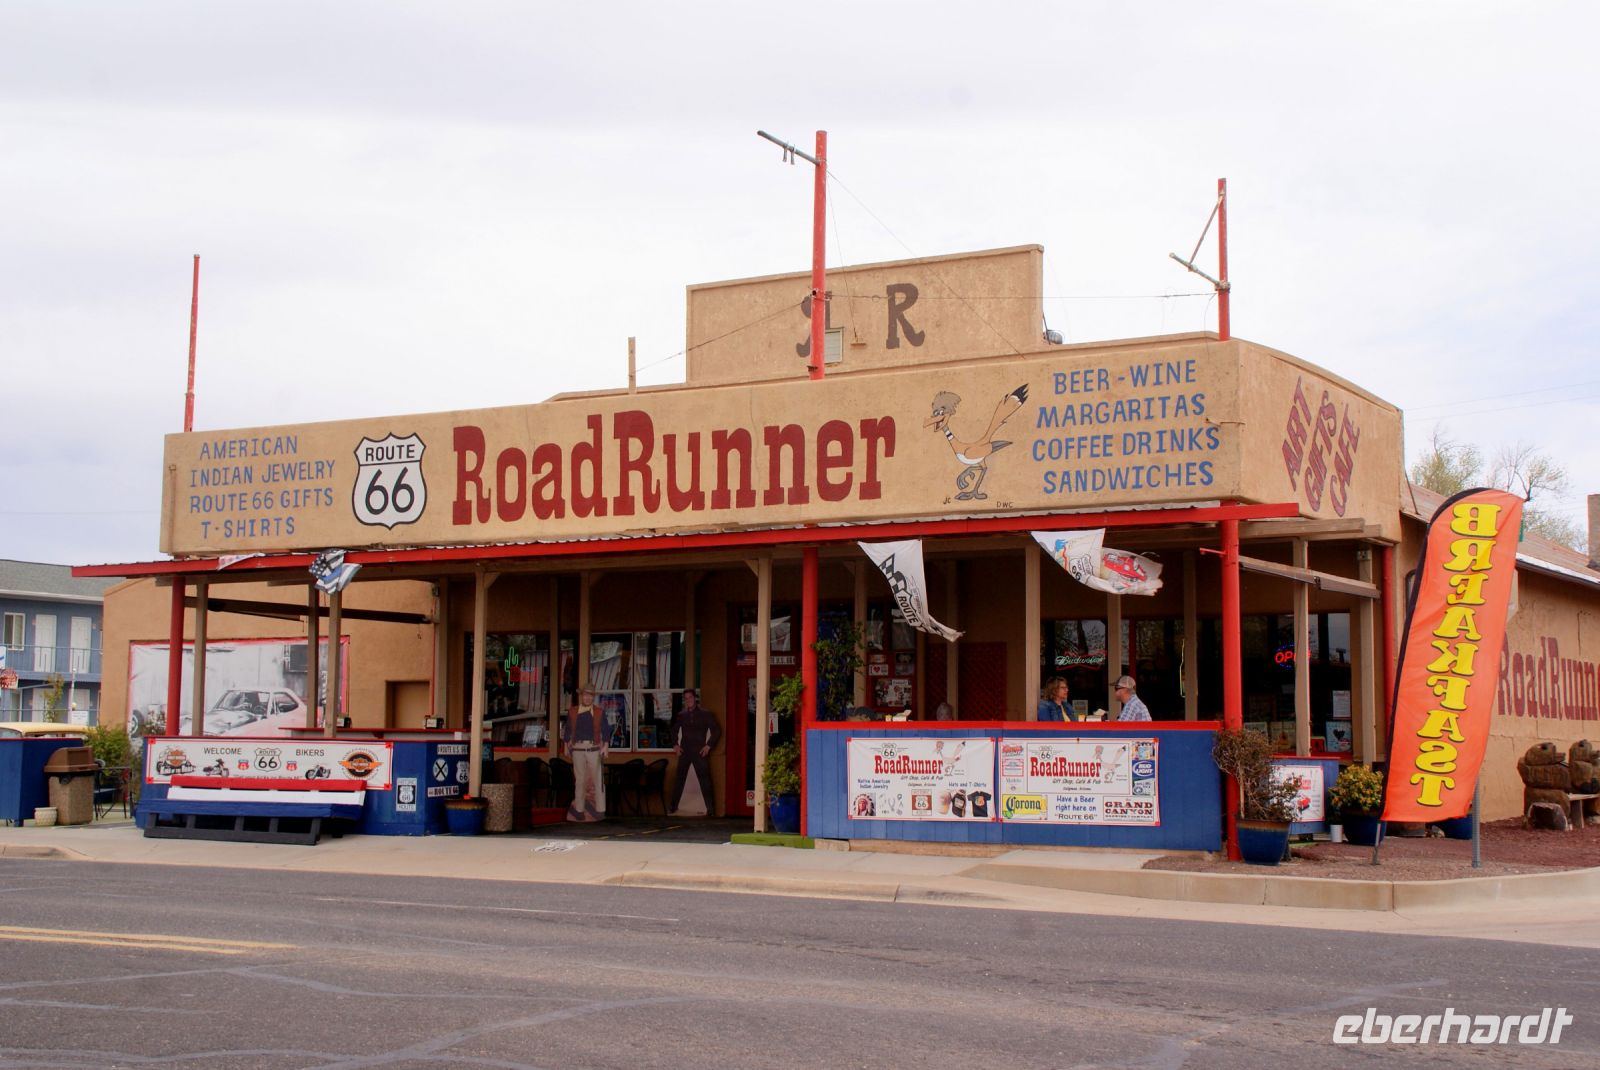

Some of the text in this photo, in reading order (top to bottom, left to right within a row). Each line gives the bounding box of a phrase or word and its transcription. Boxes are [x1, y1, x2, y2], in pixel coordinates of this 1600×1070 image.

[886, 283, 925, 349] R
[1053, 368, 1110, 395] BEER
[1036, 393, 1206, 429] MARGARITAS
[1032, 426, 1221, 462] COFFEE DRINKS
[1281, 375, 1313, 492] ART
[199, 436, 298, 460] AMERICAN
[365, 444, 416, 462] ROUTE
[1304, 389, 1338, 513] GIFTS
[190, 459, 337, 488] INDIAN JEWELRY
[452, 410, 897, 526] RoadRunner
[1042, 460, 1215, 495] SANDWICHES
[189, 487, 334, 514] ROUTE 66 GIFTS
[365, 466, 416, 515] 66
[898, 595, 919, 624] ROUTE
[1498, 631, 1600, 721] RoadRunn
[203, 746, 243, 756] WELCOME
[258, 757, 278, 769] 66
[295, 748, 325, 757] BIKERS
[883, 749, 895, 757] 66
[874, 755, 944, 775] RoadRunner
[1030, 757, 1102, 777] RoadRunner
[917, 800, 927, 808] 66
[1006, 797, 1041, 811] Corona
[1056, 795, 1072, 803] Have
[1056, 804, 1071, 812] right
